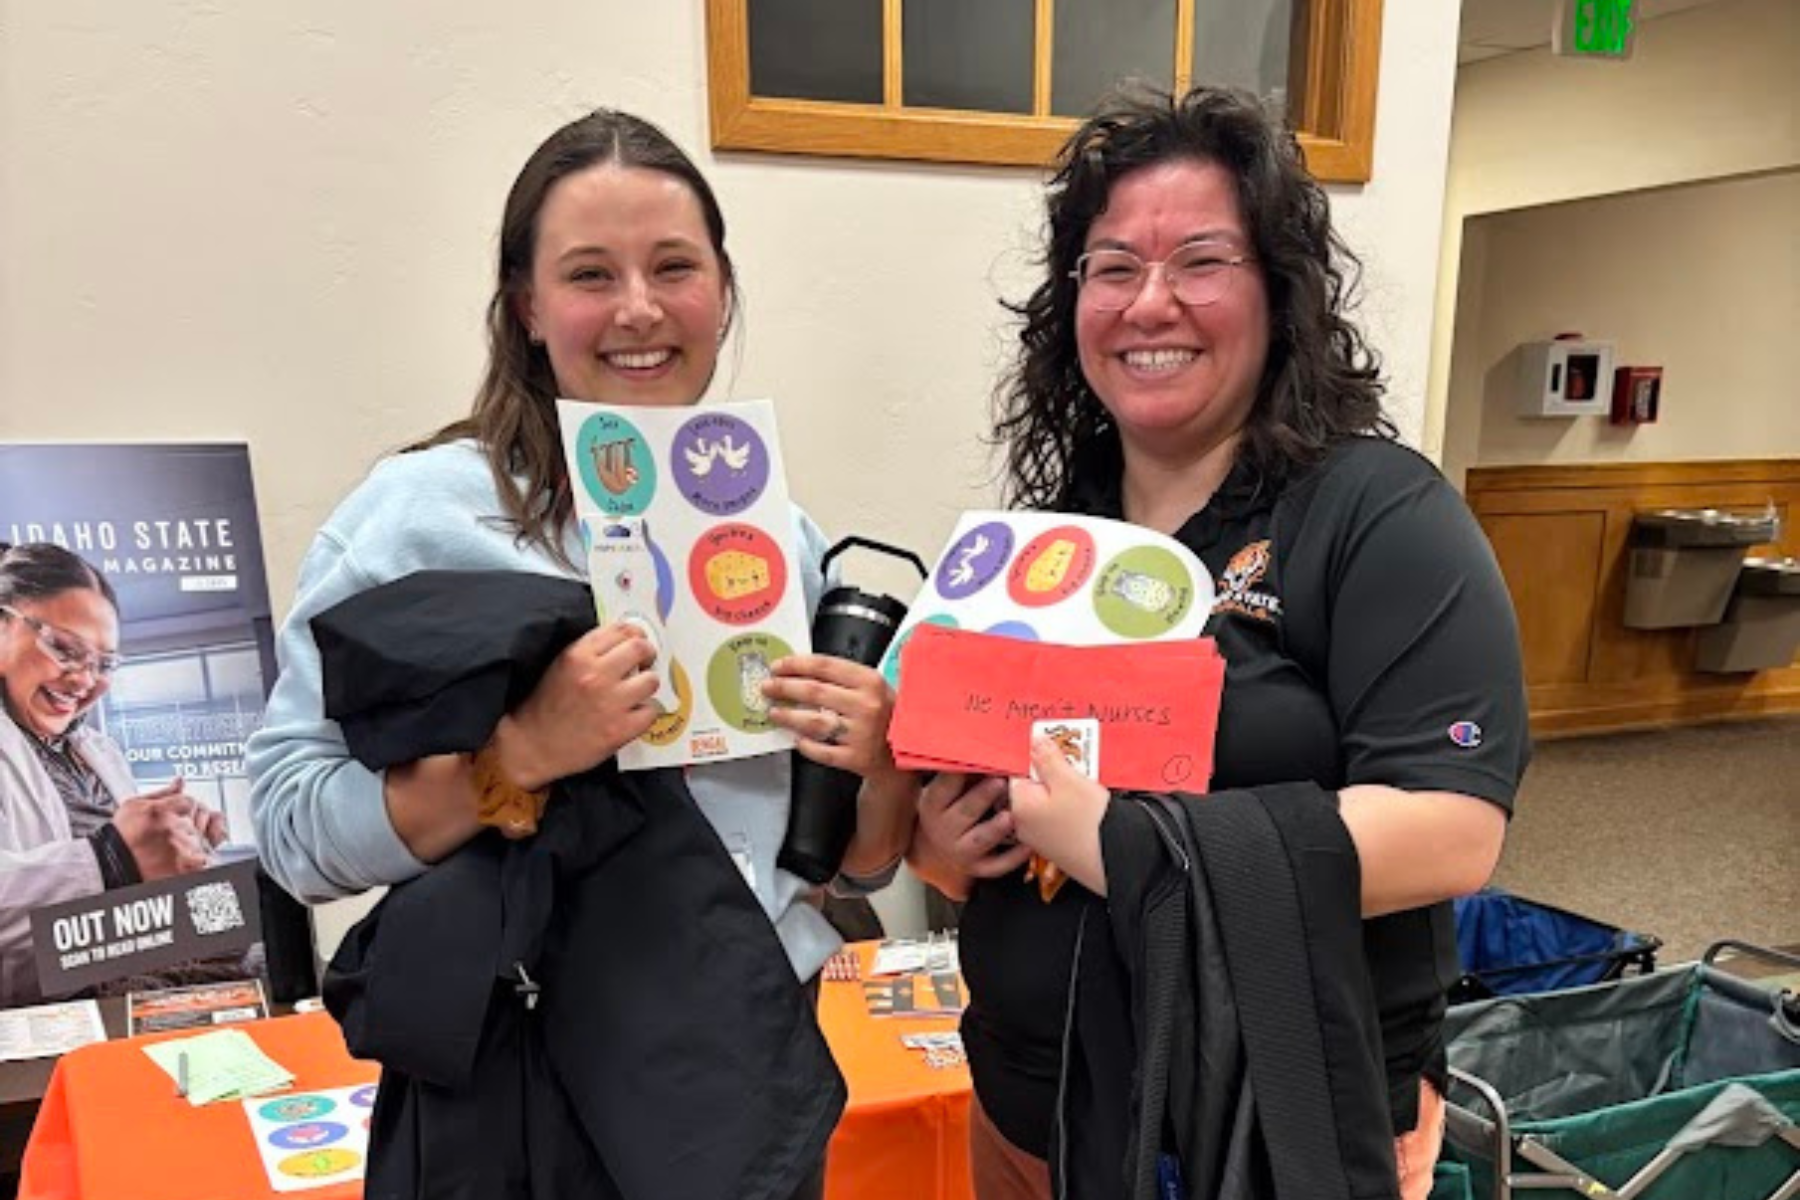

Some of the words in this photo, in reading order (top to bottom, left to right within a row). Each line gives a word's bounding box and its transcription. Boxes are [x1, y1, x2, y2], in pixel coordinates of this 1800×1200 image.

[9, 521, 116, 550] IDAHO
[133, 518, 234, 549] STATE
[102, 555, 237, 574] MAGAZINE
[1088, 703, 1171, 726] Nurses
[127, 748, 163, 762] OUR
[173, 762, 198, 777] TO
[53, 911, 105, 951] OUT
[113, 894, 174, 937] NOW
[59, 951, 90, 970] SCAN
[92, 945, 105, 961] TO
[107, 940, 135, 958] READ
[136, 930, 174, 950] ONLINE
